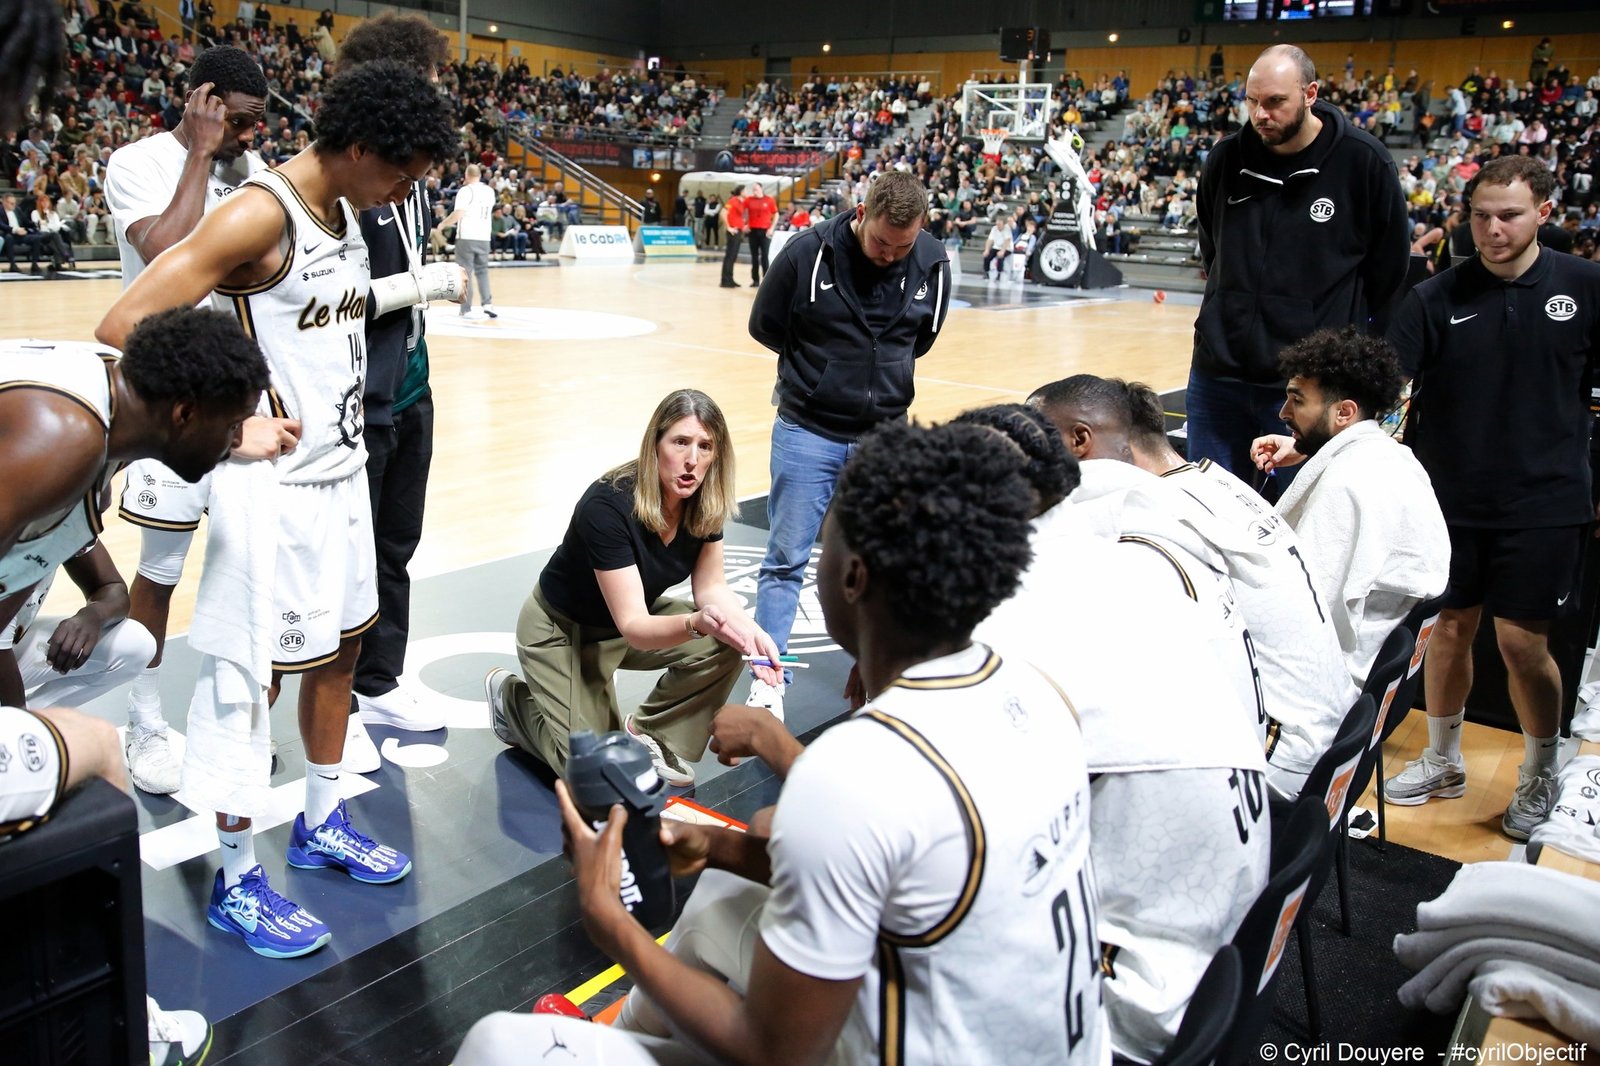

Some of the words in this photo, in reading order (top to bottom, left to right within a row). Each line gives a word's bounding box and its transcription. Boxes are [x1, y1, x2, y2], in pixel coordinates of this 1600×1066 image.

[1312, 203, 1332, 216] STB
[311, 267, 336, 278] SUZUKI
[297, 296, 331, 330] Le
[1549, 301, 1575, 313] STB
[347, 332, 363, 374] 14
[140, 494, 155, 505] STB
[283, 635, 302, 646] STB
[25, 738, 41, 765] STB
